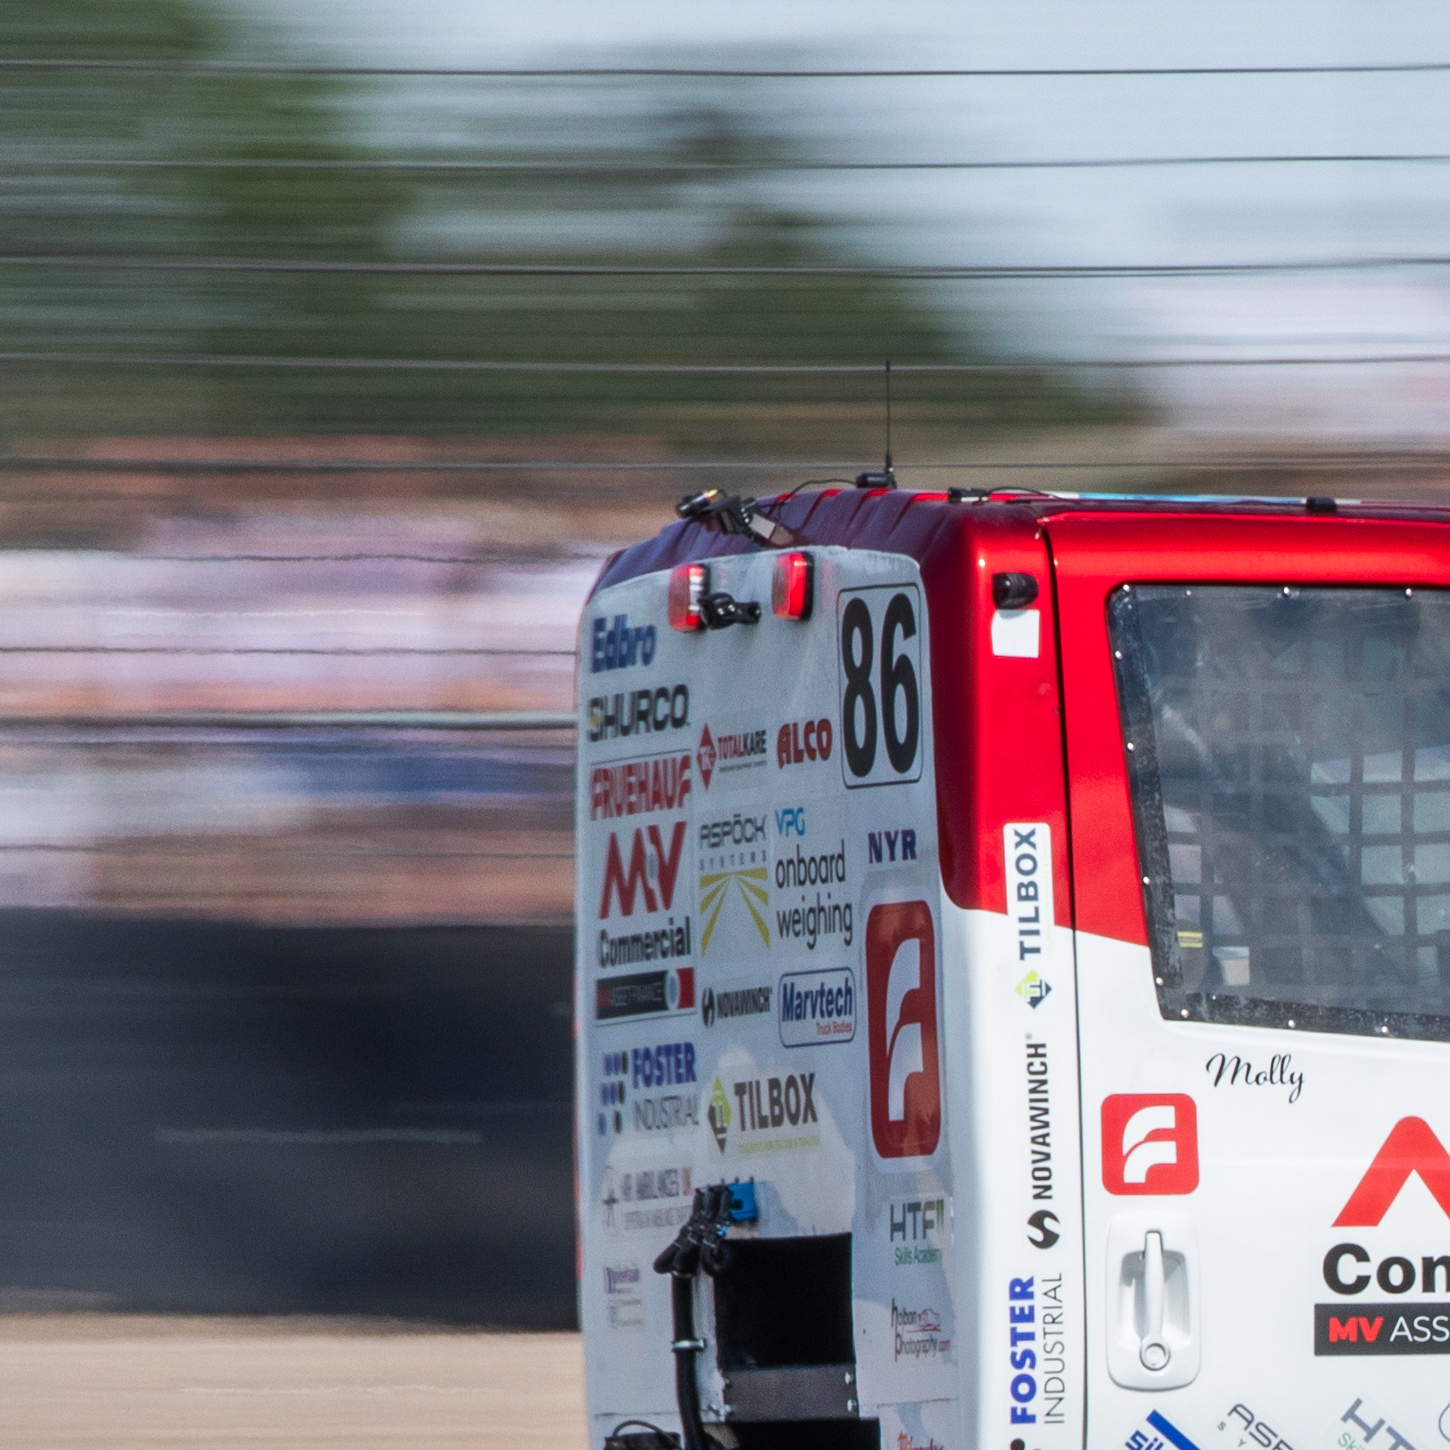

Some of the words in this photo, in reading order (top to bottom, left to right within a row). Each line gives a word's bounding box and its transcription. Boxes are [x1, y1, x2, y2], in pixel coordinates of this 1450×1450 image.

[591, 614, 656, 673] Edbro
[842, 593, 919, 778] 86
[588, 684, 689, 742] SHURCO
[718, 730, 766, 760] TOTALKARE
[777, 718, 832, 768] ALCO
[590, 754, 692, 821] FRUEHAUF
[700, 813, 767, 849] ASPÖCK
[775, 807, 805, 837] VPG
[868, 829, 917, 864] NYR
[598, 821, 687, 920] MV
[775, 839, 846, 889] onboard
[1014, 828, 1041, 961] TILBOX
[599, 917, 692, 969] Commercial
[777, 895, 853, 950] weighing
[782, 977, 852, 1021] Marvtech
[632, 1042, 697, 1089] FOSTER
[1205, 1053, 1304, 1104] Molly
[735, 1072, 818, 1132] TILBOX
[1026, 1043, 1053, 1199] NOVAWINCH
[890, 1201, 936, 1242] HTF
[1009, 1276, 1036, 1424] FOSTER
[1042, 1273, 1065, 1424] INDUSTRIAL
[1329, 1317, 1383, 1343] MV
